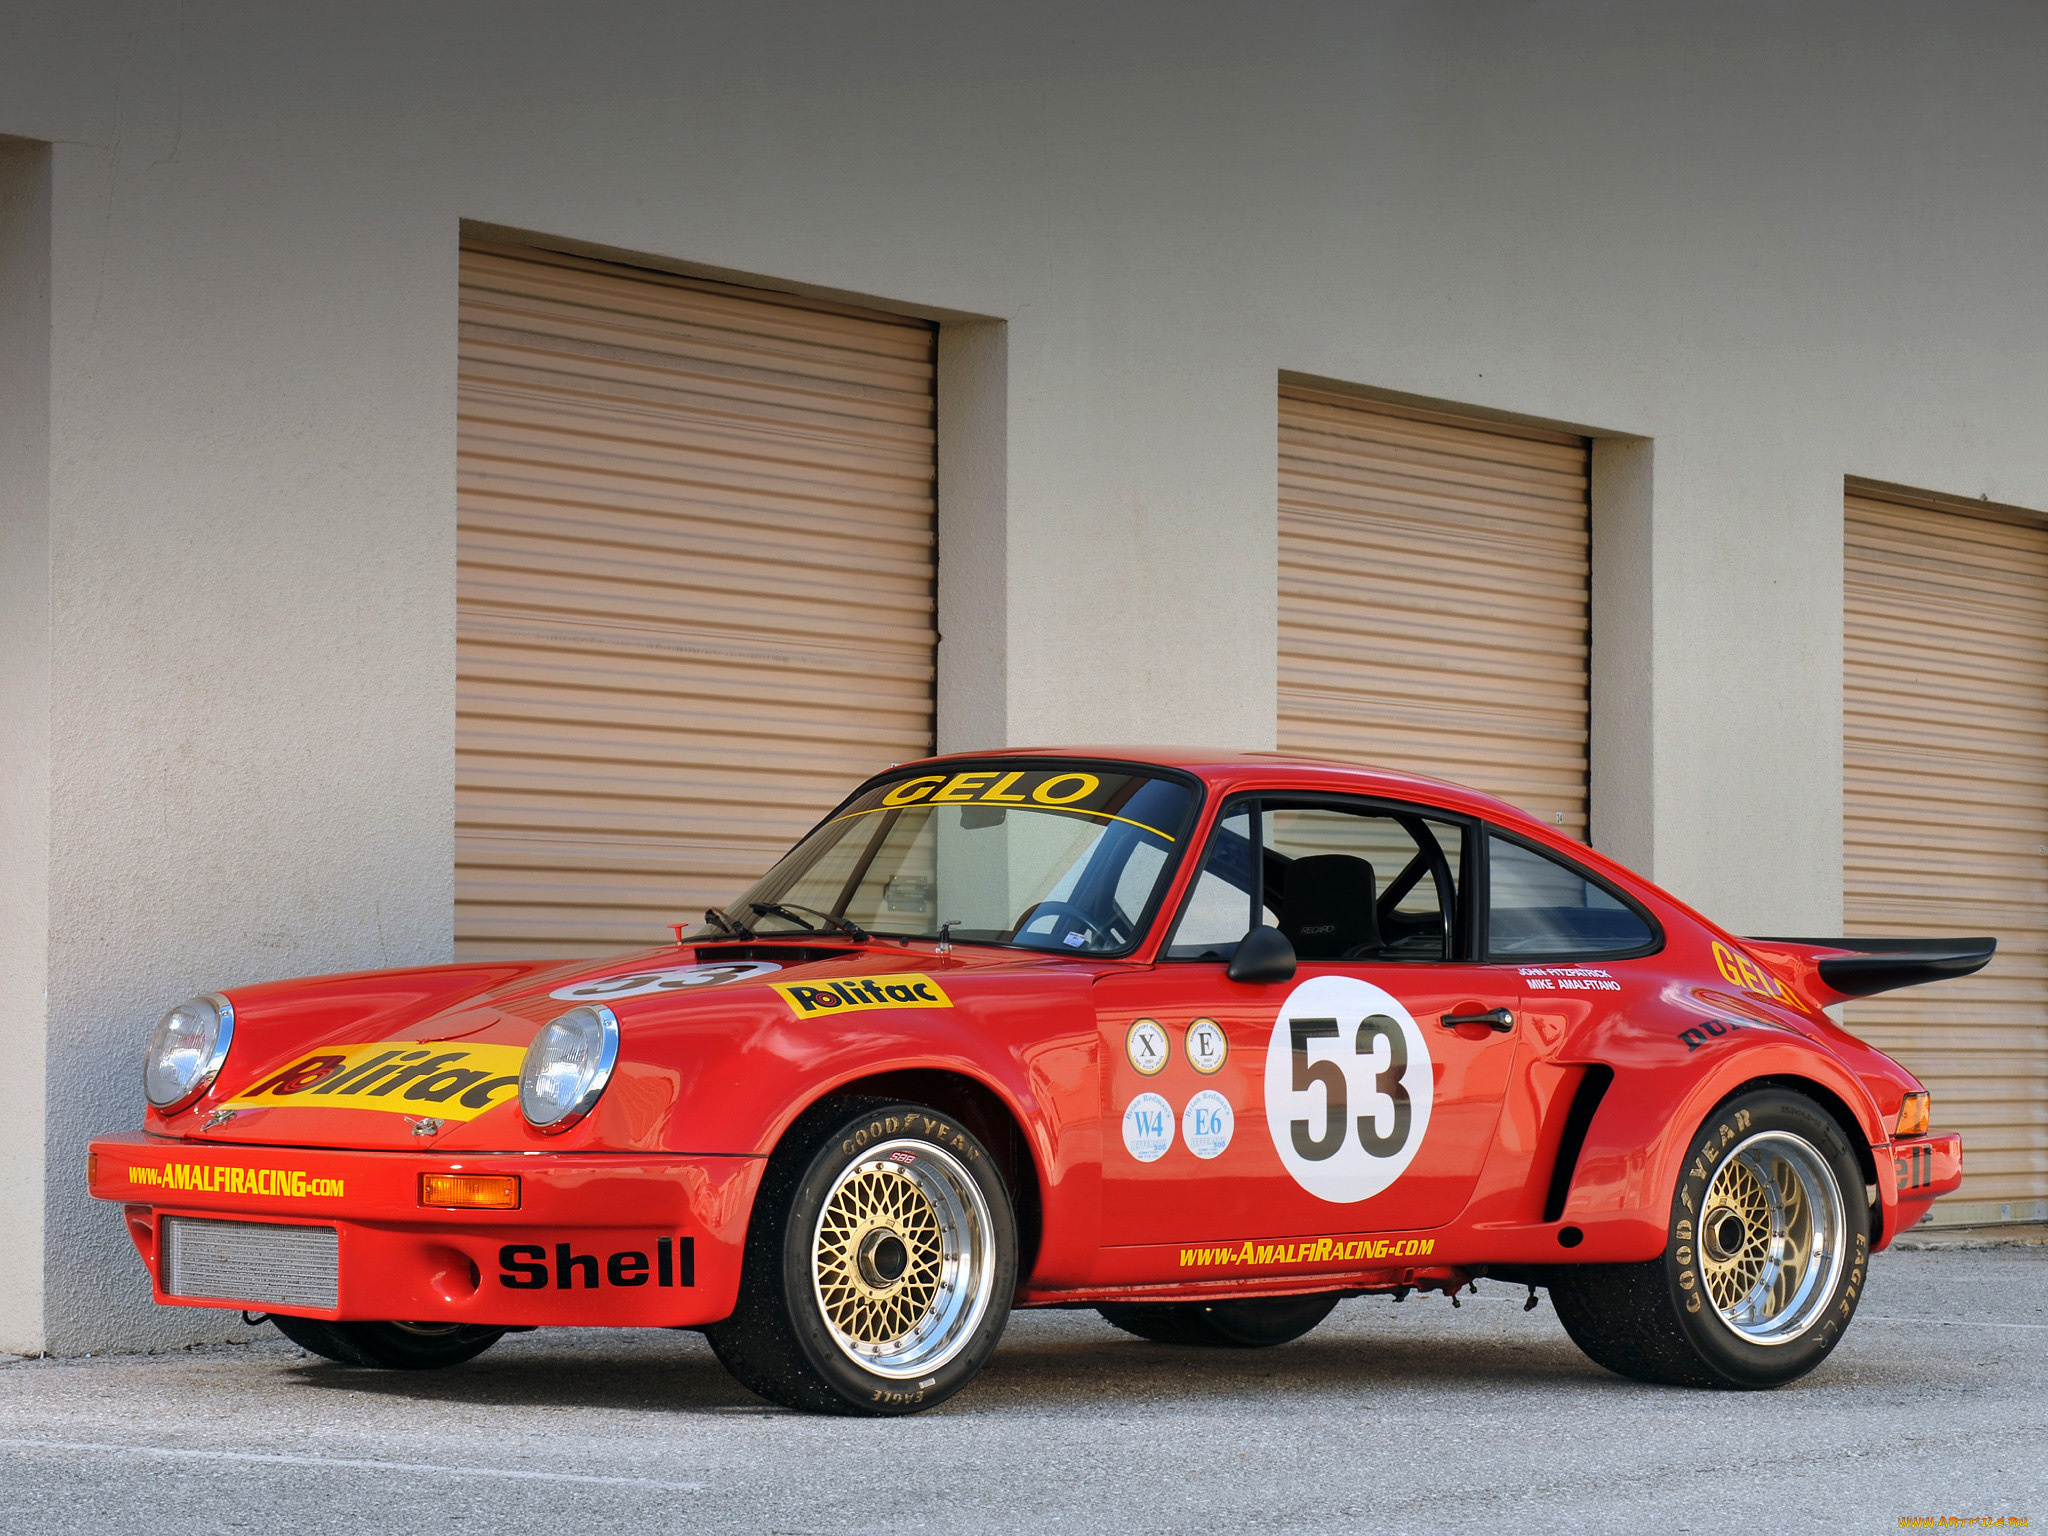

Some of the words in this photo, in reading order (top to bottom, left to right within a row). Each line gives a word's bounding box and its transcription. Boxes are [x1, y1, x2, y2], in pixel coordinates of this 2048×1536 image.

[882, 772, 1099, 805] GELO
[572, 965, 758, 996] 53
[1518, 968, 1547, 976] JOHN
[1546, 968, 1612, 978] FITZPATRICK
[1526, 979, 1556, 990] MIKE
[1557, 979, 1622, 991] AMALFITANO
[1712, 941, 1812, 1014] GELO
[787, 979, 940, 1011] Polifac
[1138, 1033, 1157, 1057] X
[1198, 1032, 1215, 1057] E
[240, 1050, 520, 1109] Polifac
[1289, 1014, 1412, 1162] 53
[1125, 1100, 1142, 1120] Brian
[1185, 1097, 1202, 1118] Brian
[1135, 1111, 1163, 1138] W4
[1195, 1108, 1222, 1136] E6
[890, 1152, 915, 1164] BBS
[498, 1236, 694, 1290] Shell
[1839, 1232, 1867, 1319] EAGLE
[871, 1389, 924, 1405] EAGLE
